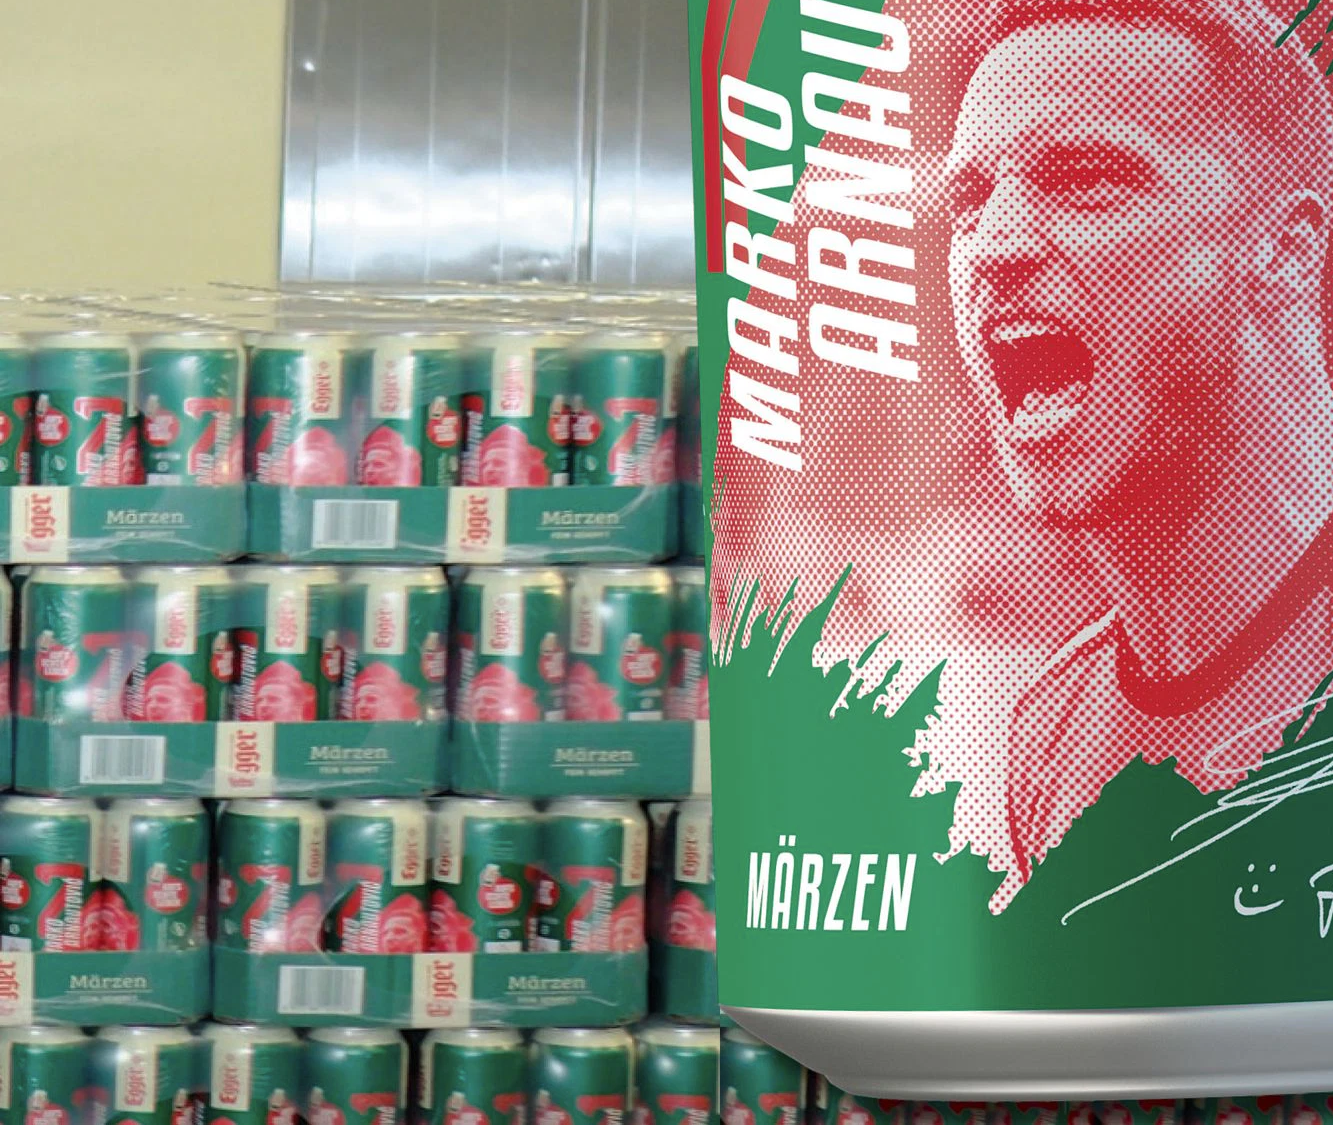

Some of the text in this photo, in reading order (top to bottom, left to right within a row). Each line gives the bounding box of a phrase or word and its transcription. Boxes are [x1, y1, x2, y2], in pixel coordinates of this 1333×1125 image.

[720, 74, 802, 472] MARKO
[106, 508, 185, 525] Märzen
[541, 509, 621, 526] Märzen
[310, 745, 388, 761] Märzen
[554, 747, 633, 763] Märzen
[746, 835, 918, 932] MÄRZEN
[69, 975, 148, 990] Märzen
[507, 975, 586, 991] Märzen
